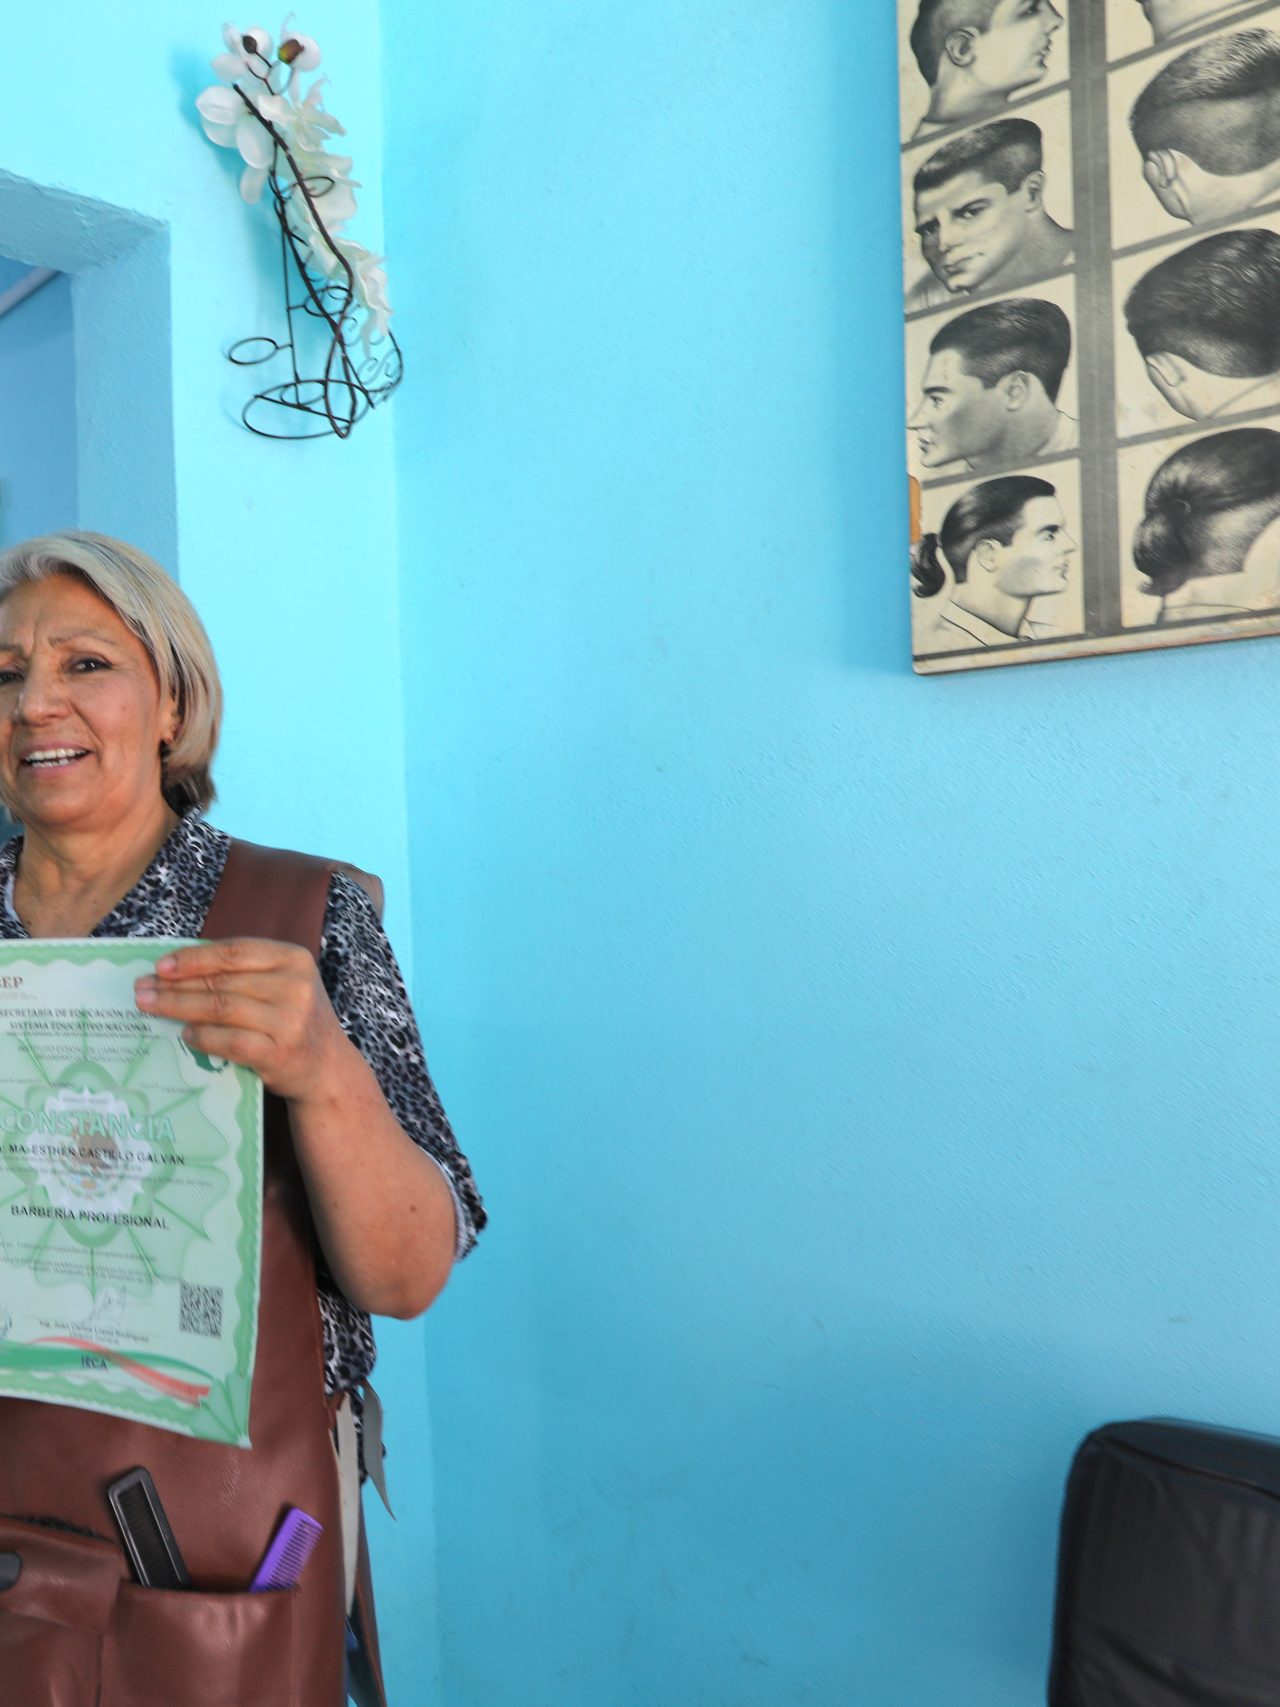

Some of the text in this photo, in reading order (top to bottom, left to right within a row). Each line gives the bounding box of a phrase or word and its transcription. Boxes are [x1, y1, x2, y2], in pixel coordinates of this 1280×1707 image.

[55, 1008, 67, 1018] DE
[9, 1021, 152, 1033] SISTEMA EDUCATIVO NACIONAL
[32, 1144, 75, 1157] ESTHER
[79, 1147, 134, 1162] CASTILLO
[79, 1209, 169, 1229] PROFESIONAL
[81, 1355, 109, 1371] IECA
